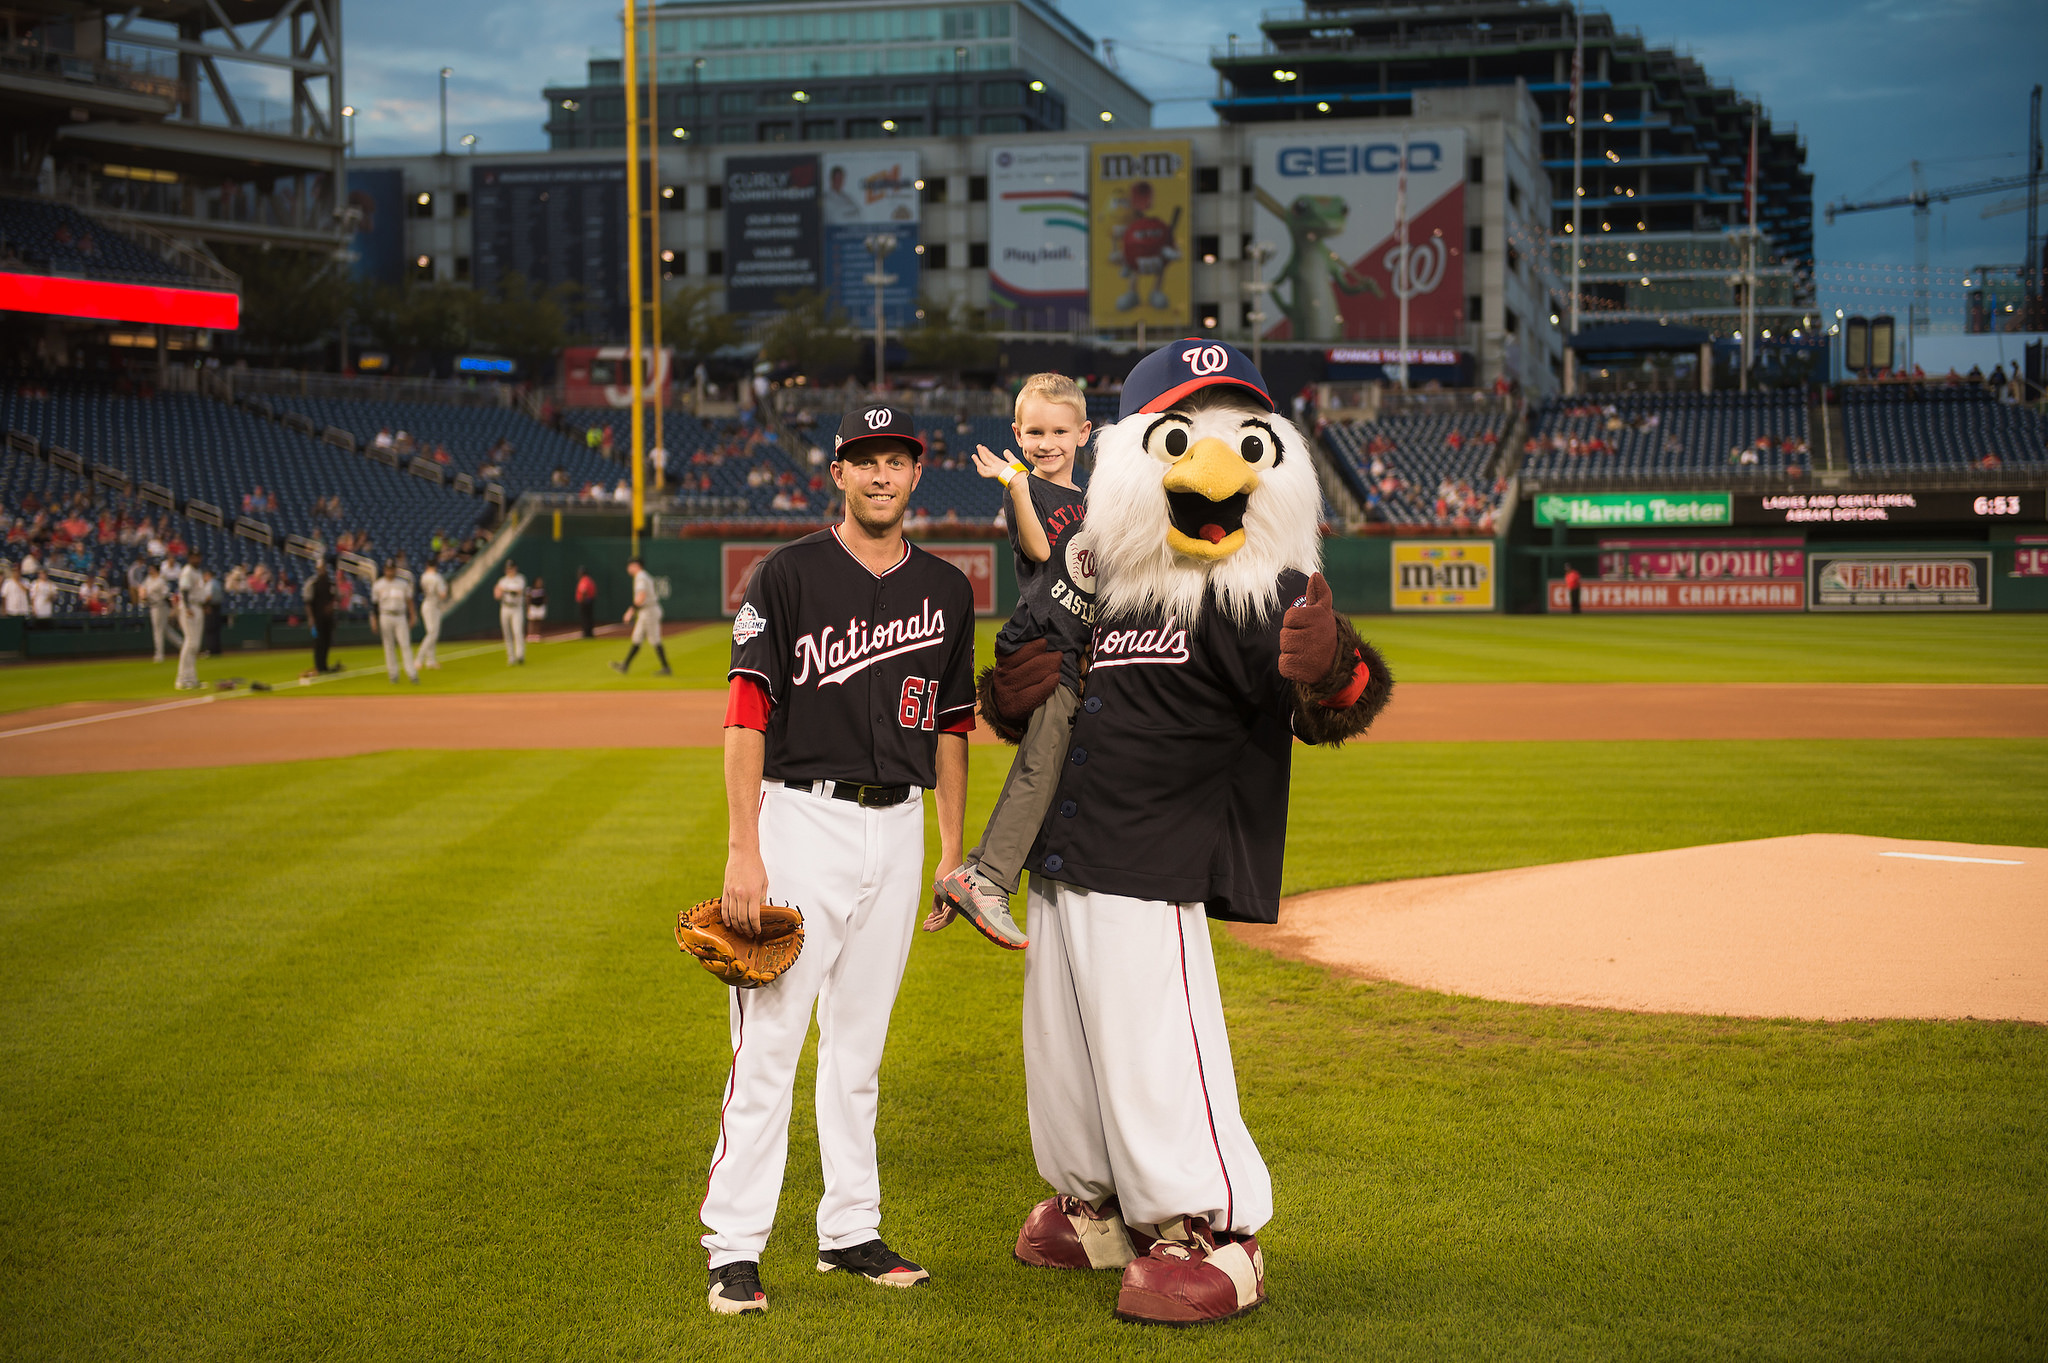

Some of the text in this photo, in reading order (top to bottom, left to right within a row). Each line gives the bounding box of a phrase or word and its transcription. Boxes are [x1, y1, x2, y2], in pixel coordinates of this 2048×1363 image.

[1278, 141, 1442, 177] GEICO
[1570, 498, 1727, 522] Harris Teeter
[1762, 495, 1807, 509] LADIES
[1808, 495, 1837, 508] AND
[1974, 495, 2020, 515] 6:53
[1553, 585, 1668, 606] CAFTSMAN
[1679, 585, 1796, 606] CRAFTSMAN
[793, 597, 945, 691] Nationals
[1091, 614, 1188, 664] ionals
[898, 675, 939, 731] 61
